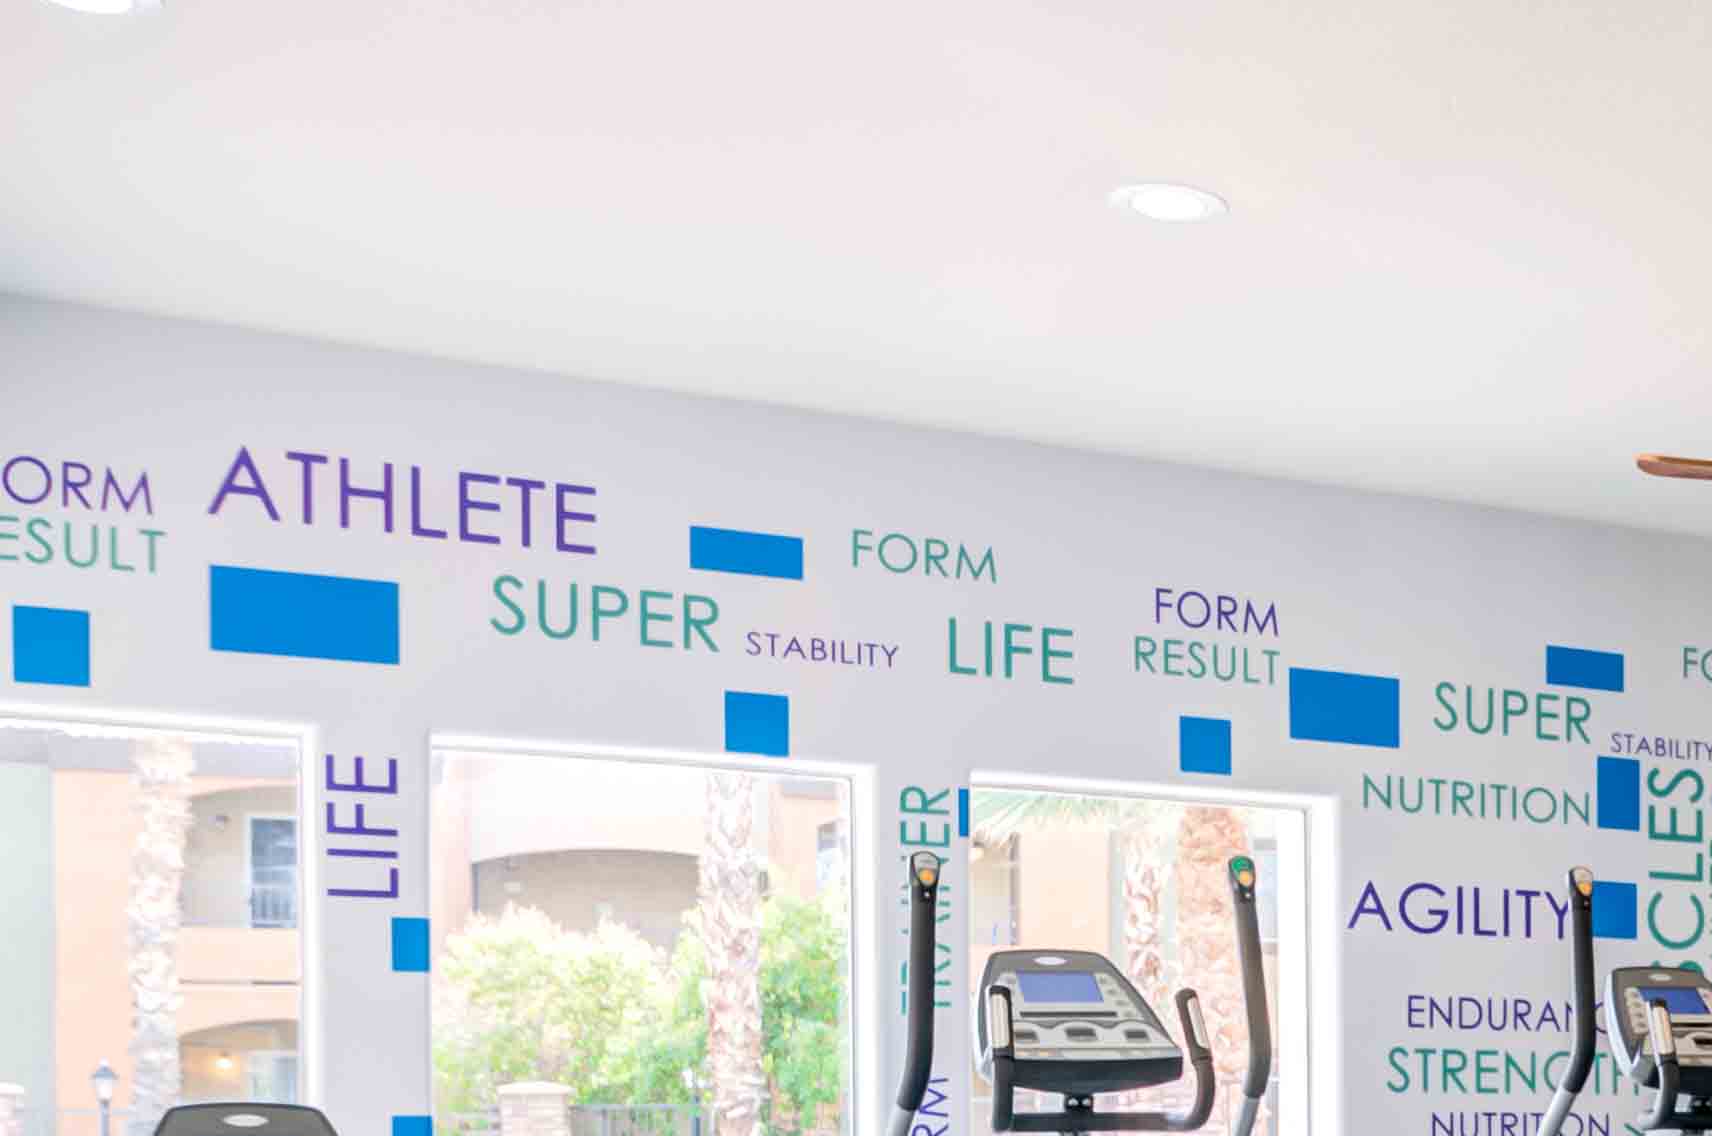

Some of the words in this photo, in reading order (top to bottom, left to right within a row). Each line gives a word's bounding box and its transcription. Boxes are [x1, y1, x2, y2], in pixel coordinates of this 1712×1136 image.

[208, 446, 596, 555] ATHLETE
[852, 529, 997, 583] FORM
[489, 575, 720, 654] SUPER
[1155, 588, 1279, 637] FORM
[746, 632, 899, 668] STABILITY
[948, 618, 1074, 684] LIFE
[1135, 636, 1280, 685] RESULT
[1434, 682, 1591, 744] SUPER
[326, 755, 398, 898] LIFE
[1363, 773, 1590, 826] NUTRITION
[1347, 880, 1569, 940] AGILITY
